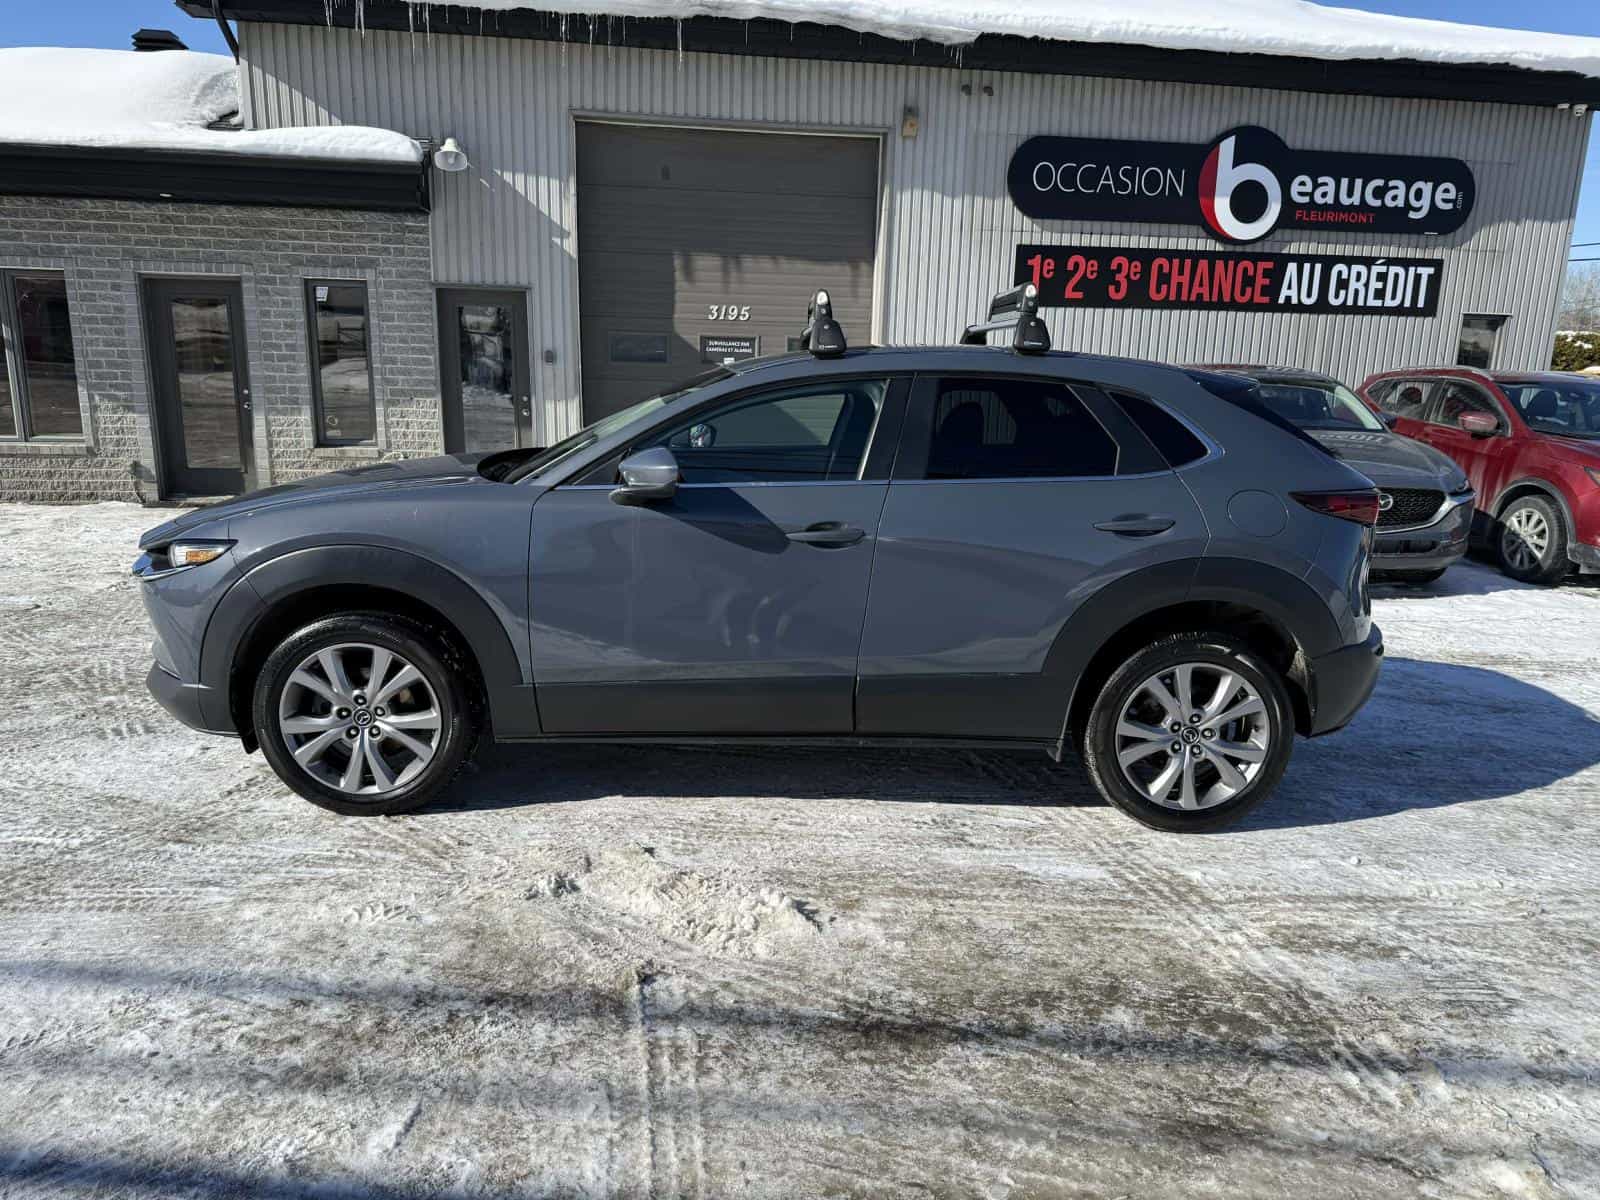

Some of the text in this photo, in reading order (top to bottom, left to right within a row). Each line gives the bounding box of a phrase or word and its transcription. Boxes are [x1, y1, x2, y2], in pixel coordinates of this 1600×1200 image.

[1033, 161, 1185, 197] OCCASION
[1295, 210, 1375, 224] FLEURIMONT
[1149, 259, 1274, 304] CHANCE
[1278, 262, 1324, 305] AU
[1328, 259, 1435, 308] CRÉDIT
[708, 304, 751, 321] 3195
